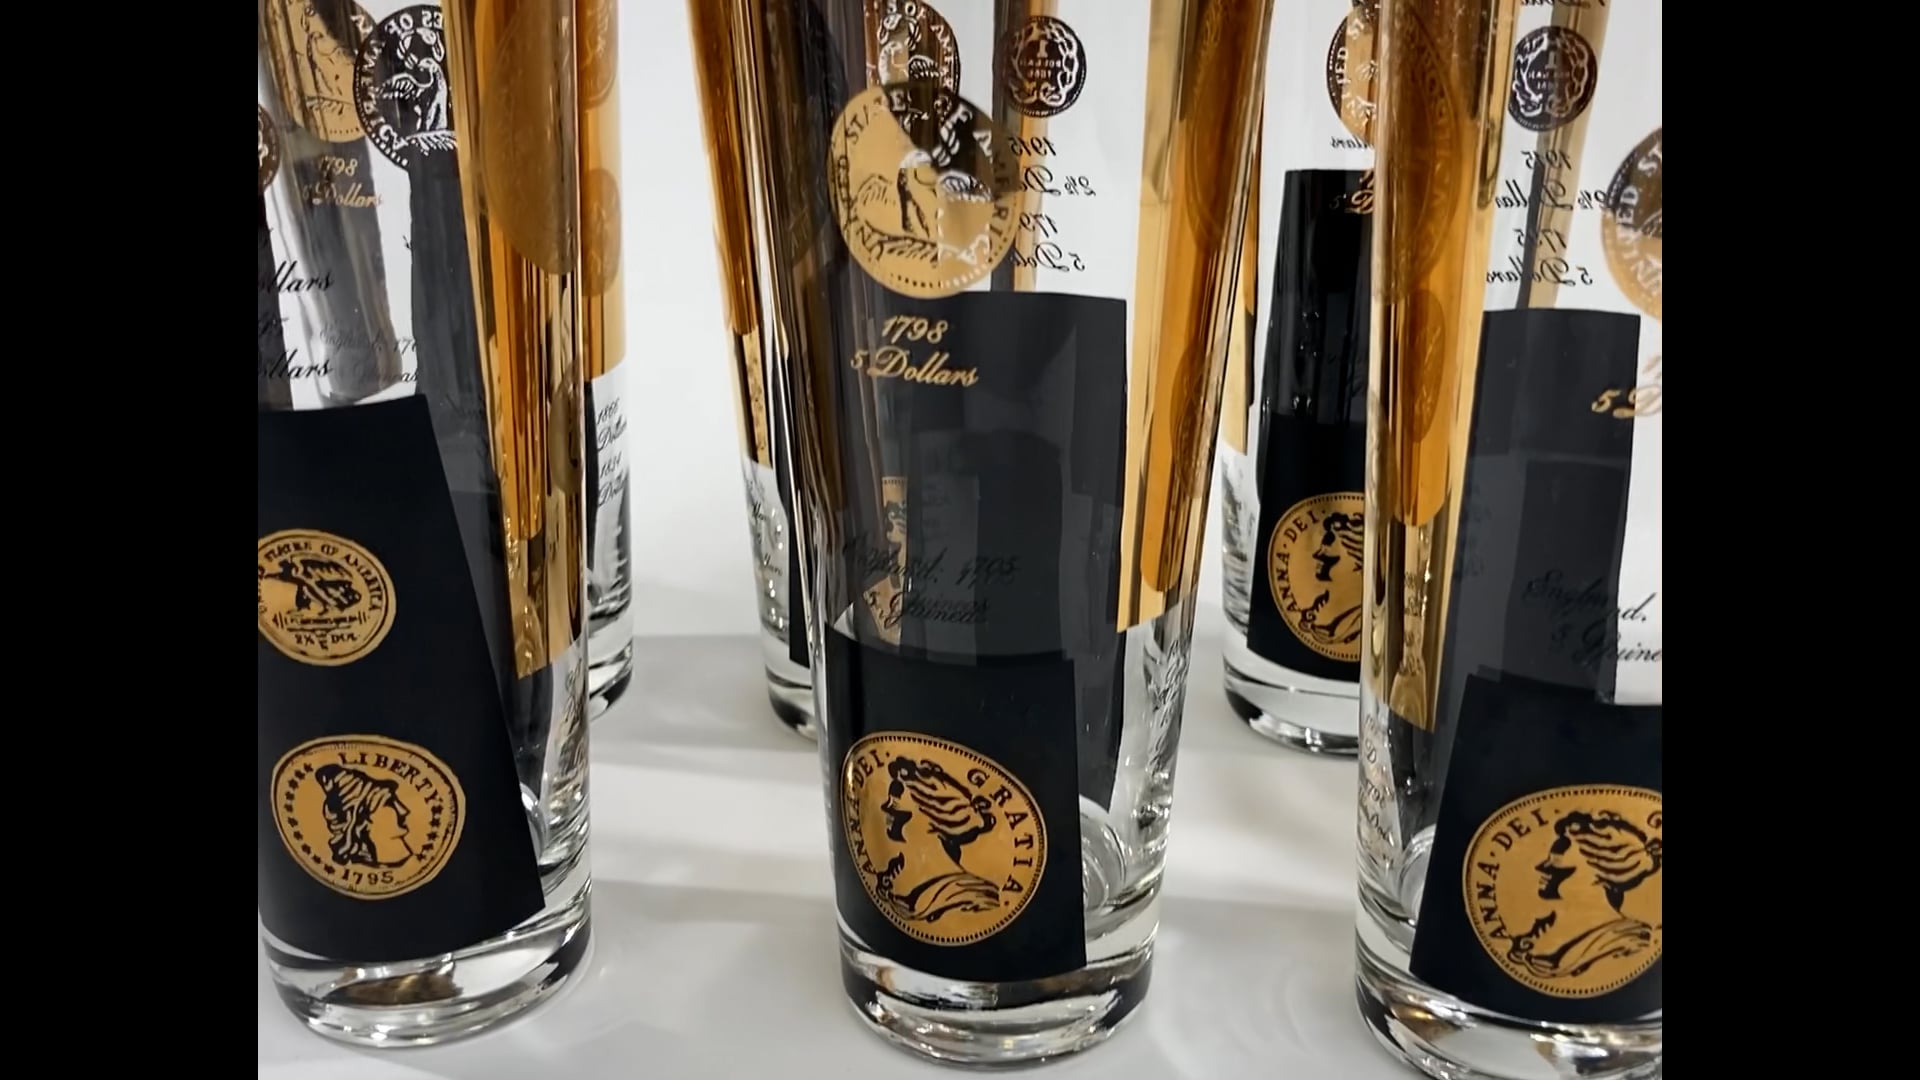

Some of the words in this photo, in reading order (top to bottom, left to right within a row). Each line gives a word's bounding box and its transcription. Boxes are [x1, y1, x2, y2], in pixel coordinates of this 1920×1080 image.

[881, 313, 951, 346] 1798
[850, 350, 866, 370] 5
[866, 344, 979, 387] Dollars
[338, 750, 442, 805] LIBERTY
[966, 768, 1035, 895] GRATIA
[340, 866, 395, 886] 1795
[1476, 867, 1508, 940] ANNA
[1494, 807, 1548, 854] DEI
